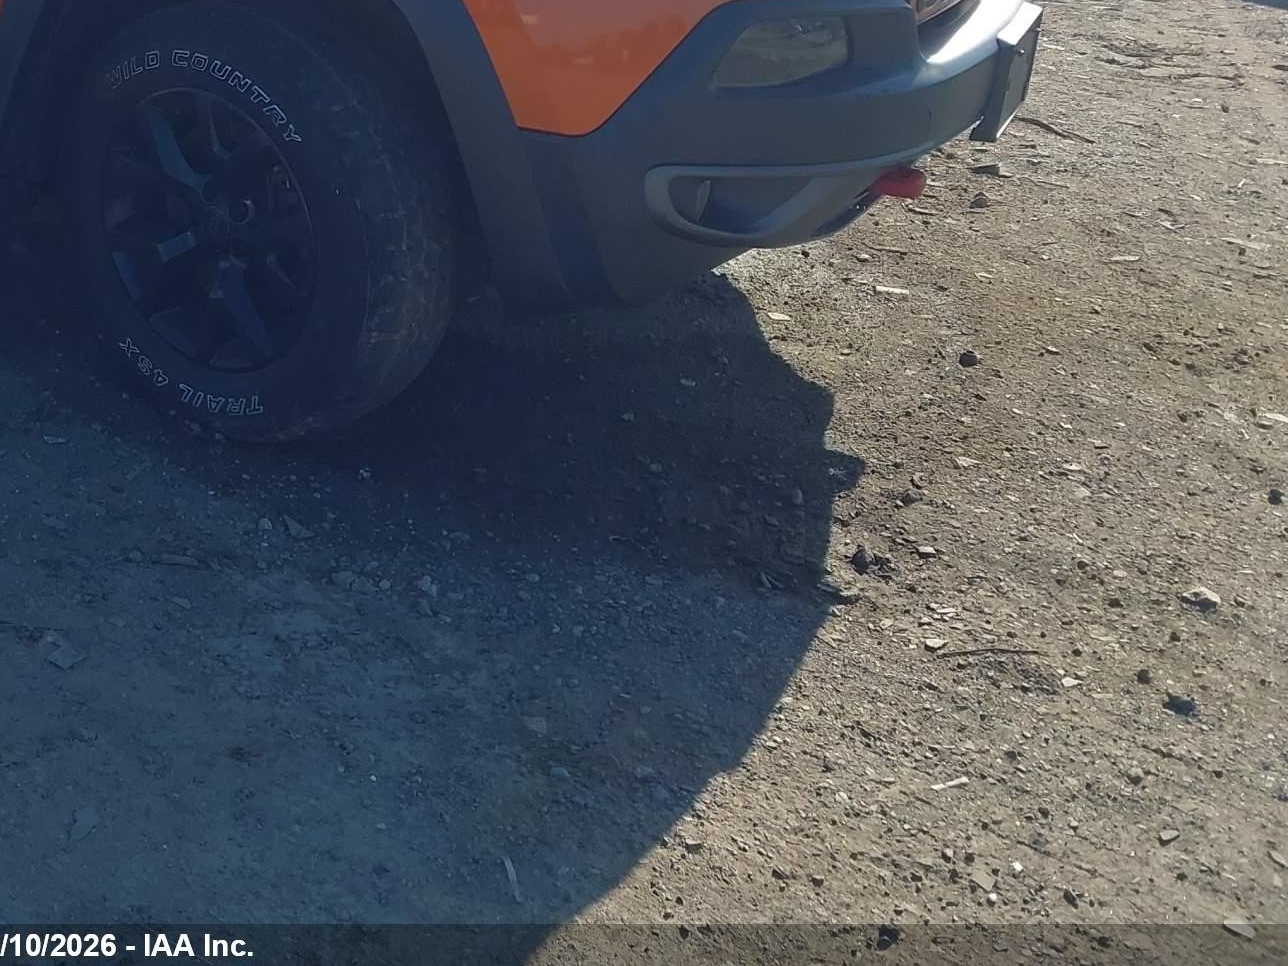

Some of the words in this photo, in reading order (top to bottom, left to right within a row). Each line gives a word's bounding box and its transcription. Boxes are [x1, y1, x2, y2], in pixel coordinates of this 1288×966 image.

[103, 50, 161, 90] WILD
[171, 49, 303, 143] COUNTRY
[177, 382, 264, 416] TRAIL
